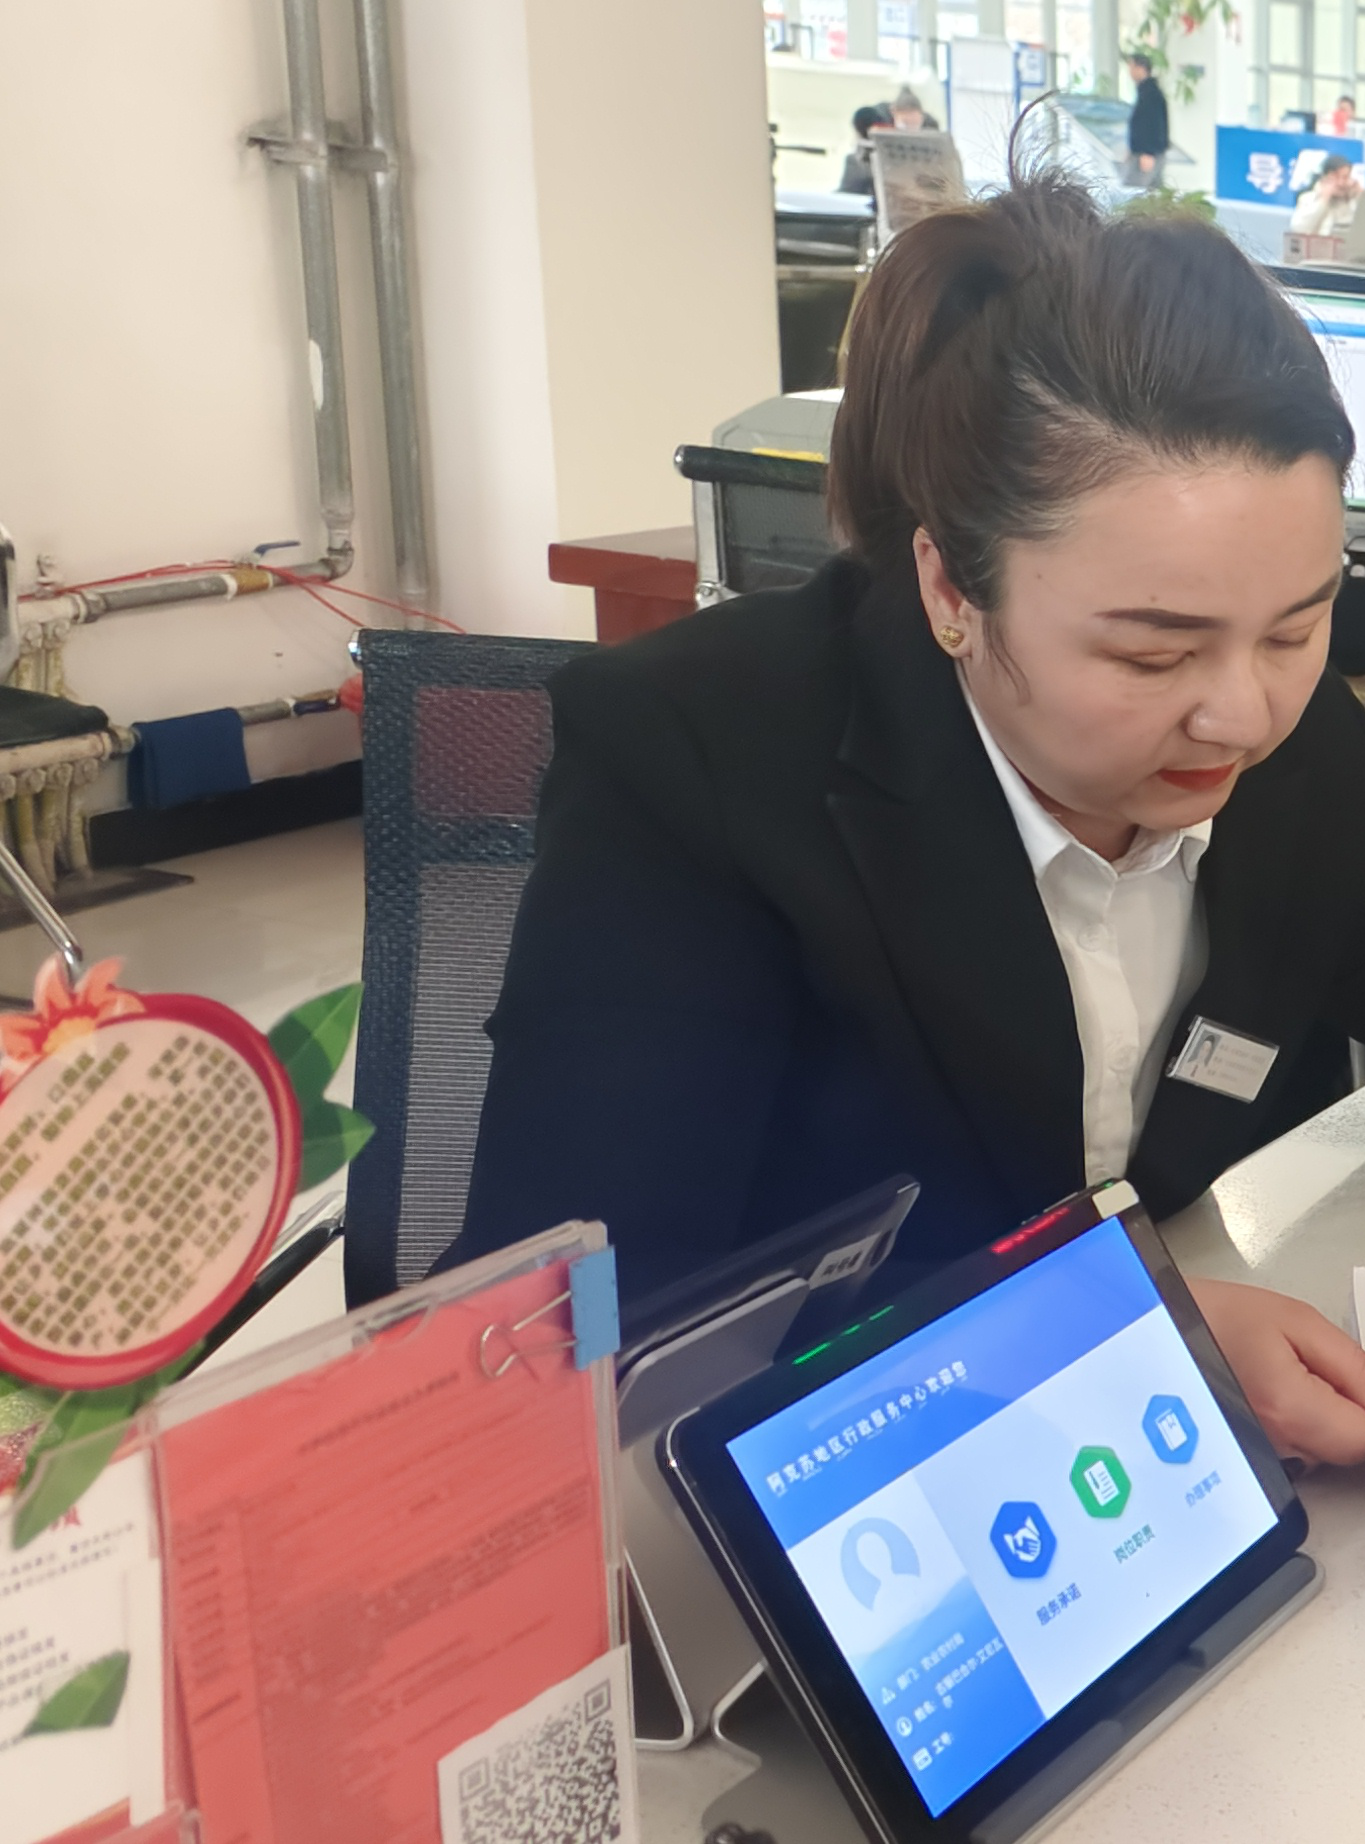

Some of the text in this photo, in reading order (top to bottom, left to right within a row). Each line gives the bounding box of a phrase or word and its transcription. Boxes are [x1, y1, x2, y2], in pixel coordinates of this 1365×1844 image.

[766, 1360, 968, 1492] 阿克苏地区行政服务中心欢迎您
[1112, 1523, 1155, 1564] 岗位职责
[1035, 1582, 1083, 1626] 服务承诺
